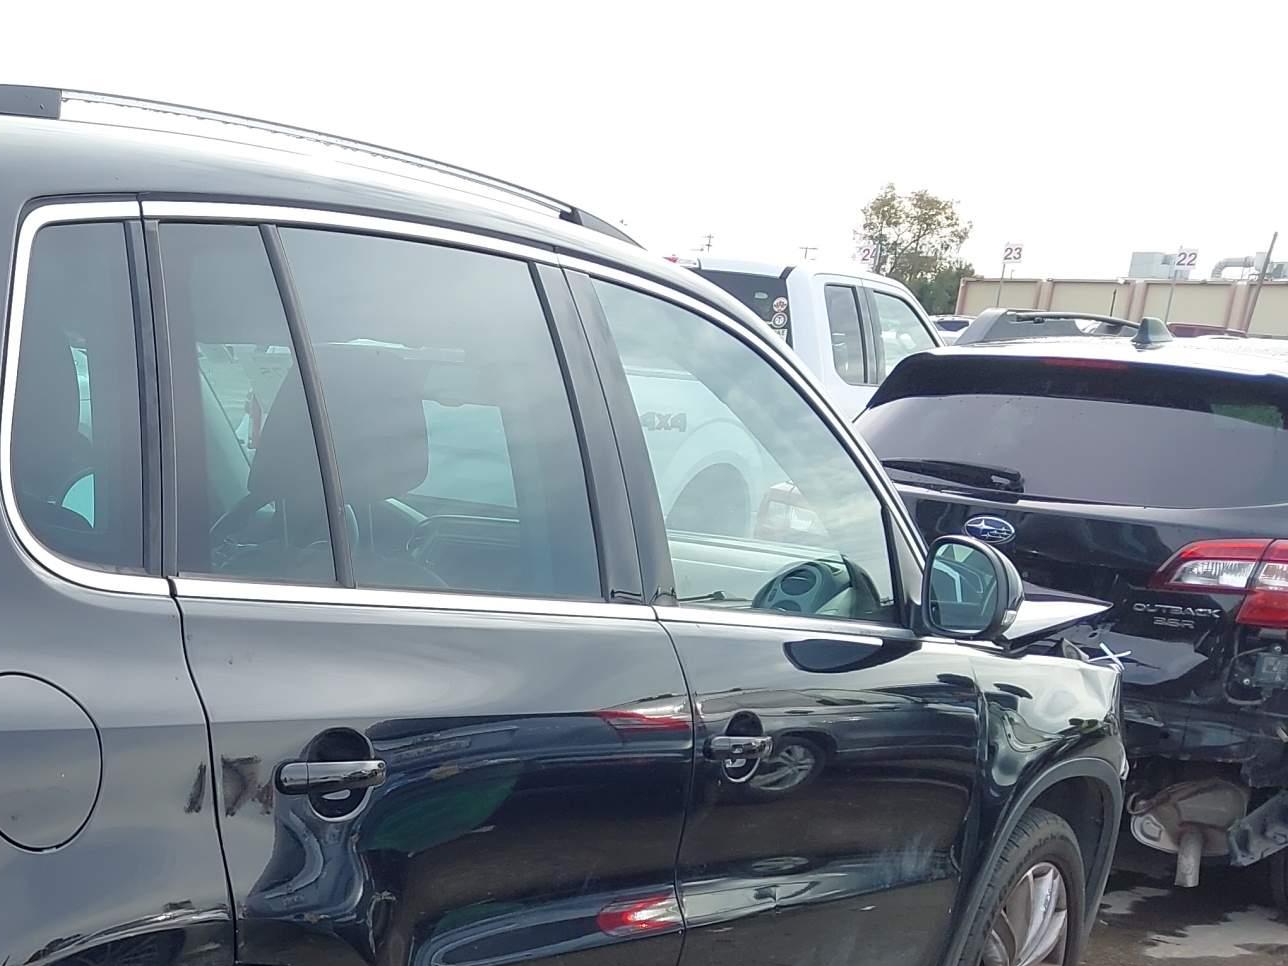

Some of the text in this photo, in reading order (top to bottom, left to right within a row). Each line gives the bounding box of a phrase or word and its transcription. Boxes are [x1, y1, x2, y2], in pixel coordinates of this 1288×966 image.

[1003, 246, 1023, 260] 23
[1175, 251, 1198, 266] 22
[1132, 603, 1222, 619] OUTBACK
